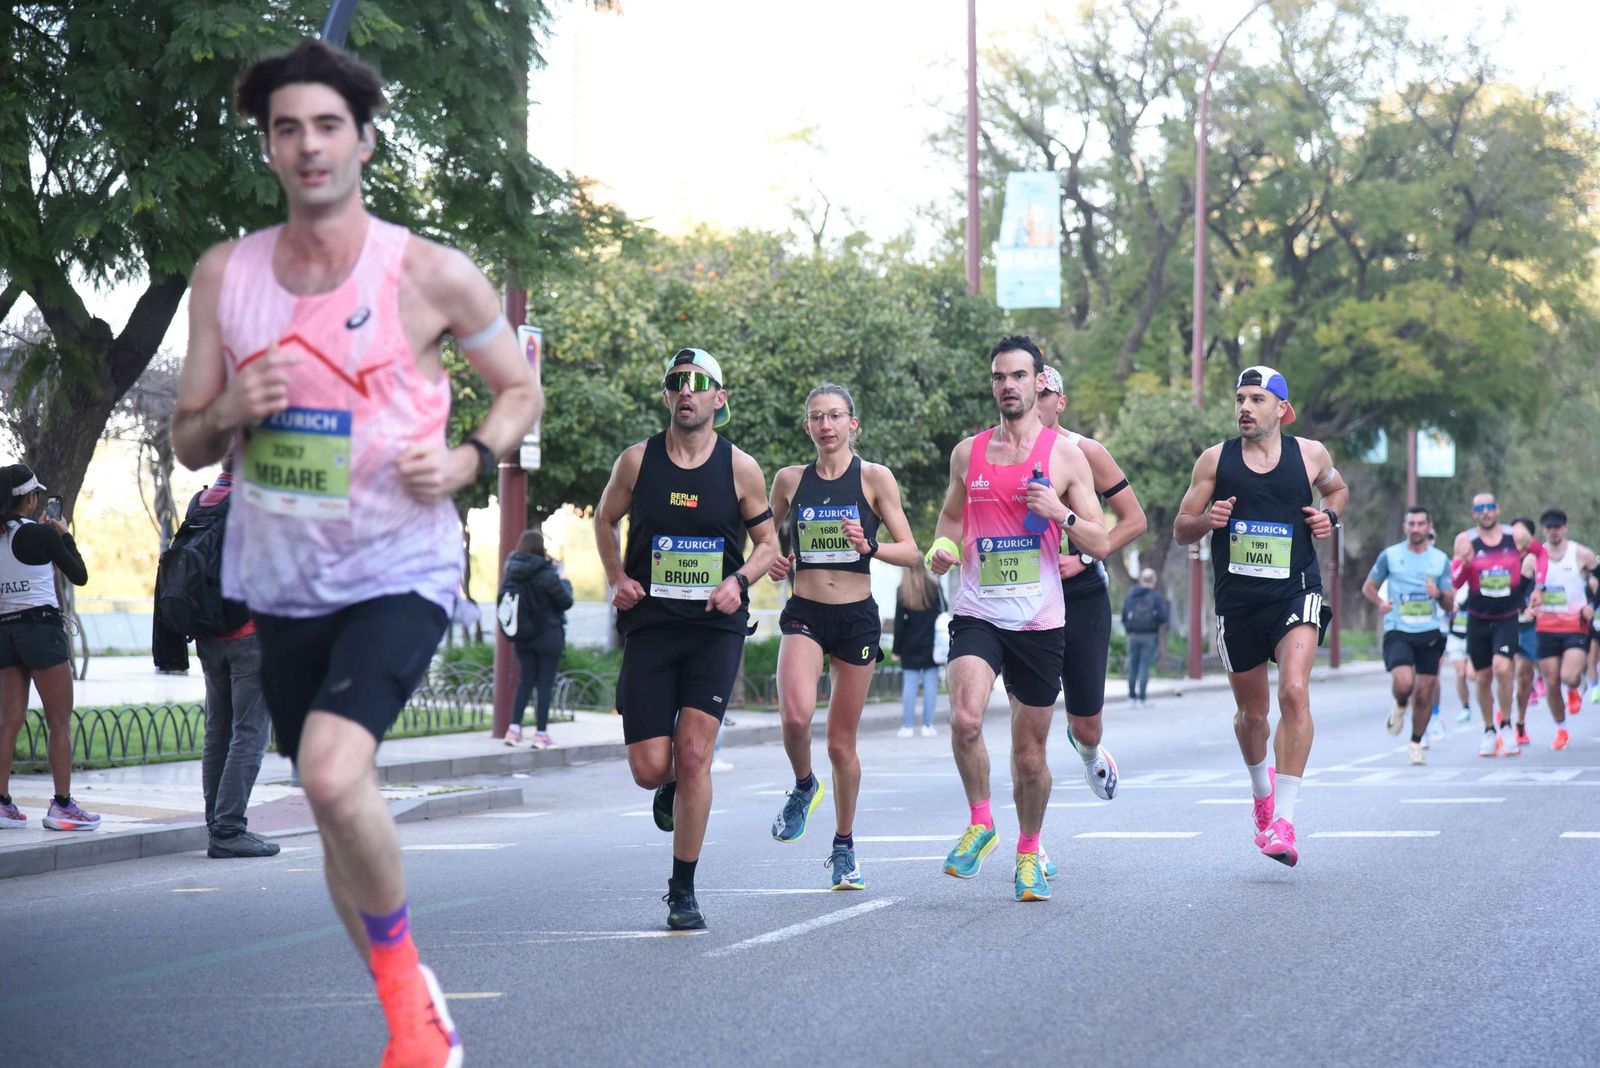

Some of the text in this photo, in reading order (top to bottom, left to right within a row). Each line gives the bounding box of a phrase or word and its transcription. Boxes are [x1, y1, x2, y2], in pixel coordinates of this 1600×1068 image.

[270, 412, 338, 430] ZURICH
[254, 461, 328, 491] MBARE
[670, 492, 699, 502] BERLIN
[670, 499, 687, 507] RUN
[818, 509, 853, 518] ZURICH
[677, 540, 716, 549] ZURICH
[811, 537, 850, 550] ANOUK
[997, 539, 1033, 549] ZURICH
[1251, 541, 1268, 550] 1991
[678, 558, 698, 568] 1609
[999, 558, 1019, 567] 1579
[1246, 552, 1273, 564] IVAN
[665, 570, 710, 584] BRUNO
[1001, 569, 1018, 583] YO
